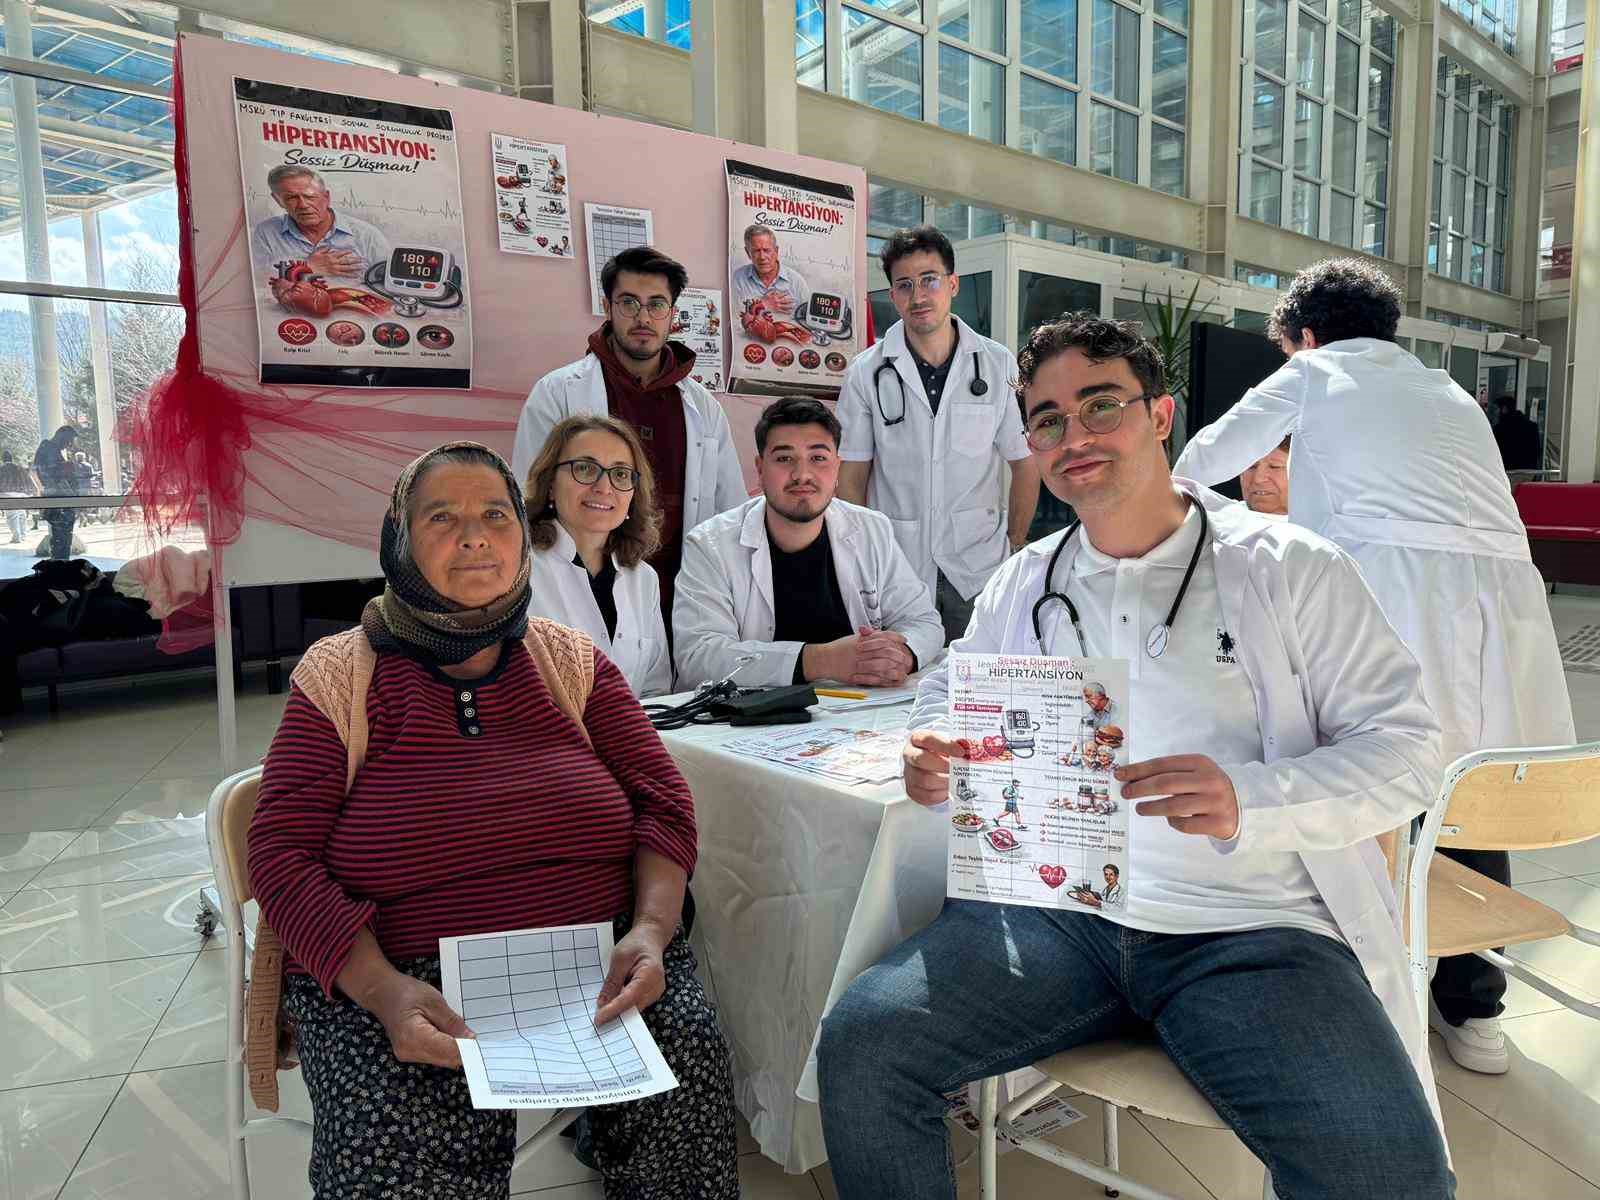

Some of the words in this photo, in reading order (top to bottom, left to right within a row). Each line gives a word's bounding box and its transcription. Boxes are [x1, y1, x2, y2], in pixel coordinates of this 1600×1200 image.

[270, 108, 286, 120] TIP
[262, 119, 437, 161] HİPERTANSİYON:
[284, 148, 337, 167] Sessiz
[340, 153, 420, 174] Düşman!
[743, 189, 844, 225] HİPERTANSİYON:
[754, 211, 785, 228] Sessiz
[787, 217, 833, 235] Düşman!
[402, 253, 425, 265] 180
[409, 265, 431, 277] 110
[821, 306, 834, 316] 110
[1216, 655, 1236, 664] USPA
[562, 1095, 593, 1104] Takip
[595, 1088, 643, 1101] Tansiyon
